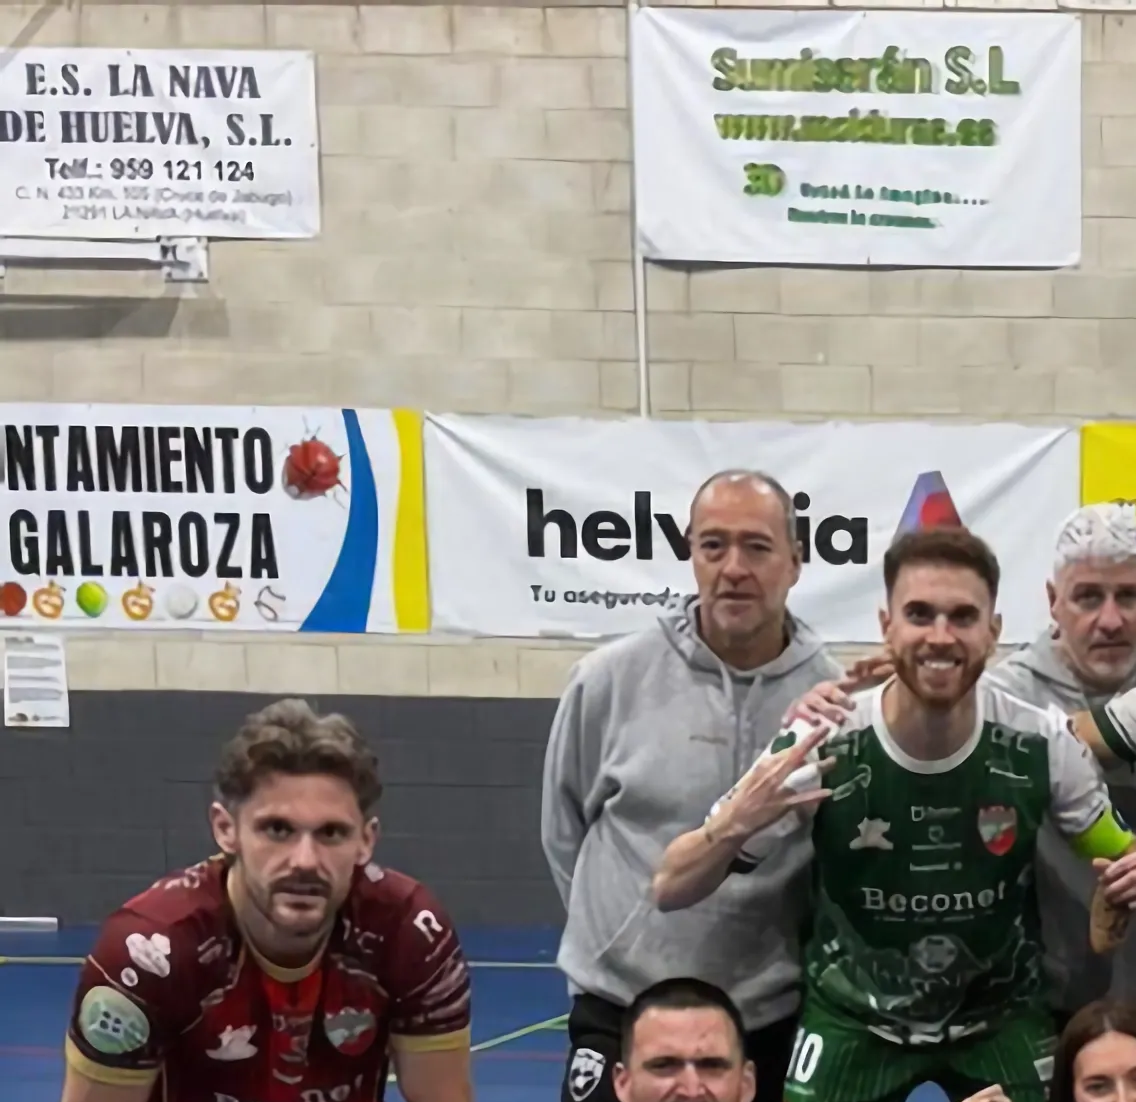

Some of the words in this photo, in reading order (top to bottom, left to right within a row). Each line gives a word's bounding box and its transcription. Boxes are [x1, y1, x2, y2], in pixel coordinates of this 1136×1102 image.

[25, 63, 92, 96] E.S.
[108, 63, 155, 97] LA
[169, 65, 261, 98] NAVA
[0, 109, 46, 143] DE
[59, 110, 211, 149] HUELVA,
[226, 113, 292, 147] S.L.
[110, 157, 153, 180] 959
[163, 159, 202, 181] 121
[214, 160, 254, 182] 124
[0, 424, 275, 494] NTAMIENTO
[9, 509, 280, 579] GALAROZA
[530, 584, 557, 602] Tu
[785, 1025, 824, 1083] 10
